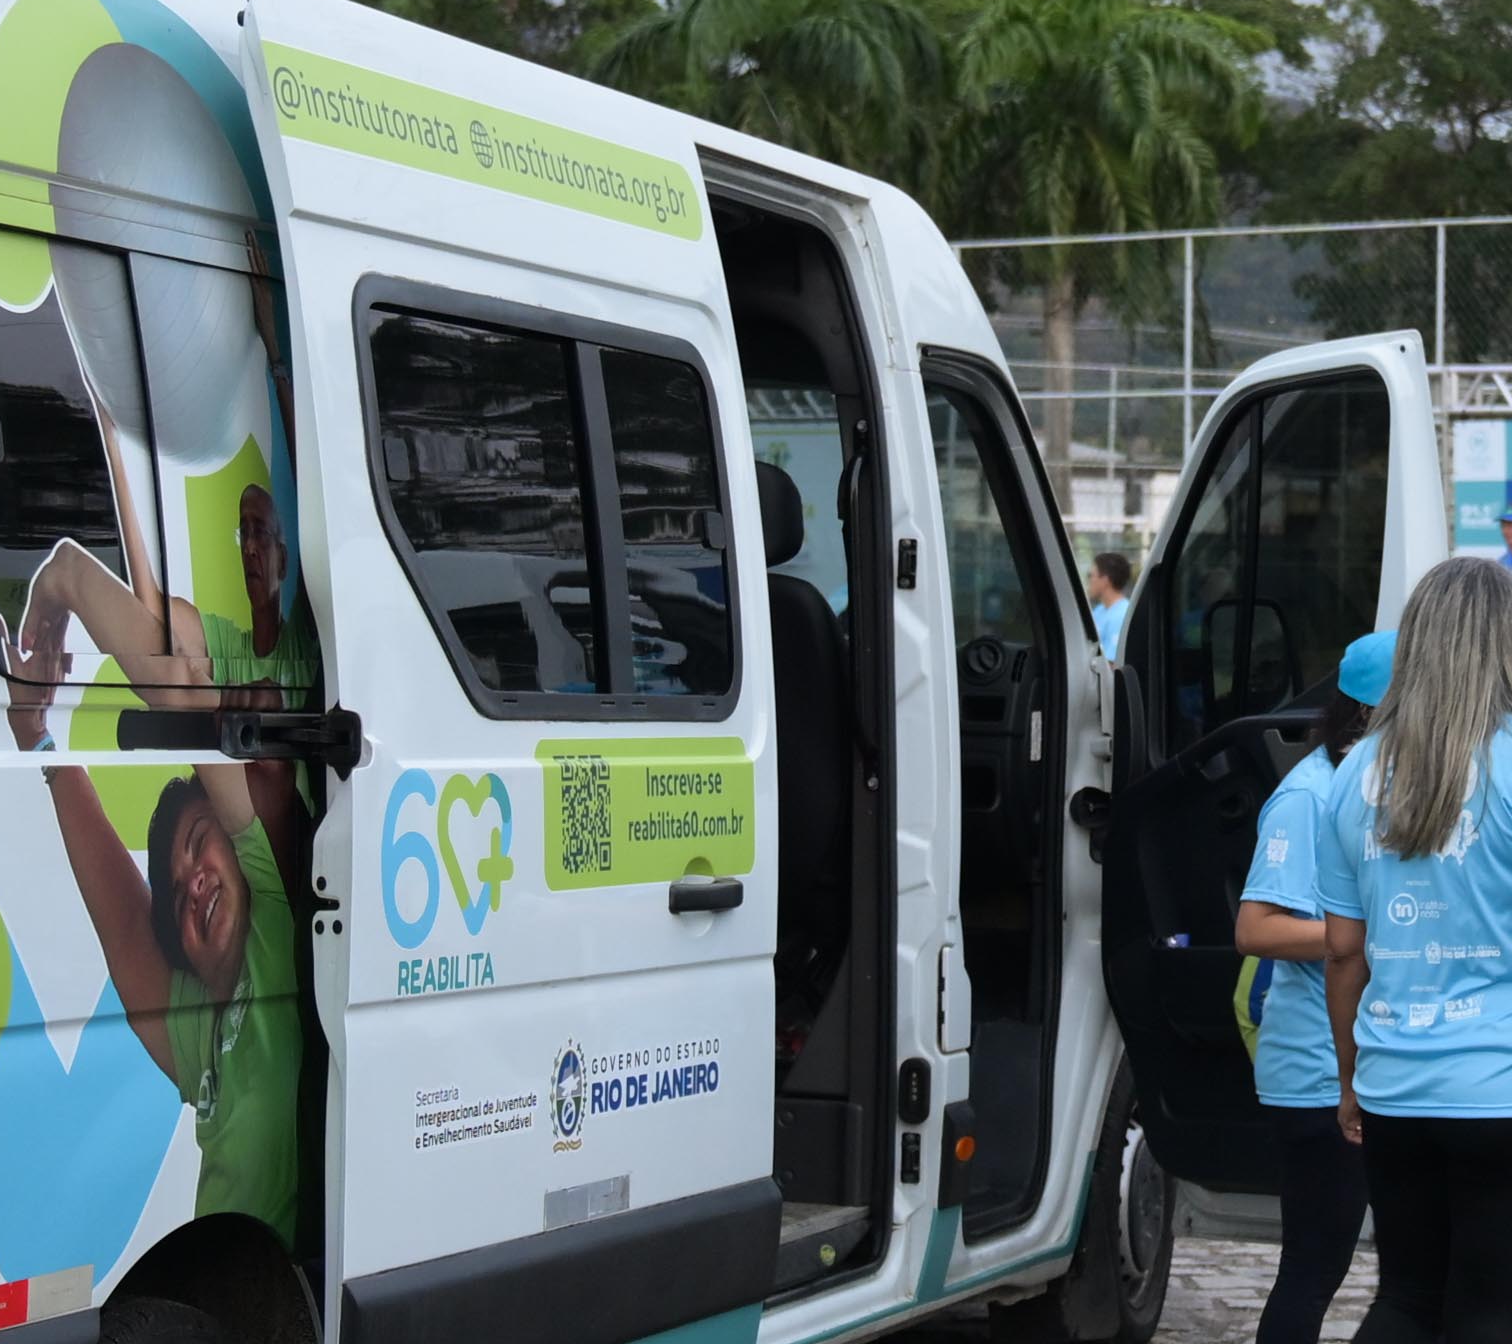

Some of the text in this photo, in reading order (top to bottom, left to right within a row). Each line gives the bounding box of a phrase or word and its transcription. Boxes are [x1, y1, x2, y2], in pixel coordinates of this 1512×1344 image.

[273, 66, 688, 223] @institutonata institutonata.org.br
[645, 767, 723, 798] Inscreva-se
[628, 808, 744, 843] reabilita60.com.br
[397, 952, 495, 996] REABILITA
[591, 1038, 721, 1075] GOVERNO DO ESTADO
[415, 1086, 459, 1108] Secretaria
[591, 1061, 720, 1115] RIO DE JANEIRO
[415, 1093, 537, 1128] Intergeracional de Juventude
[415, 1112, 532, 1149] e Envelhecimento Saudável
